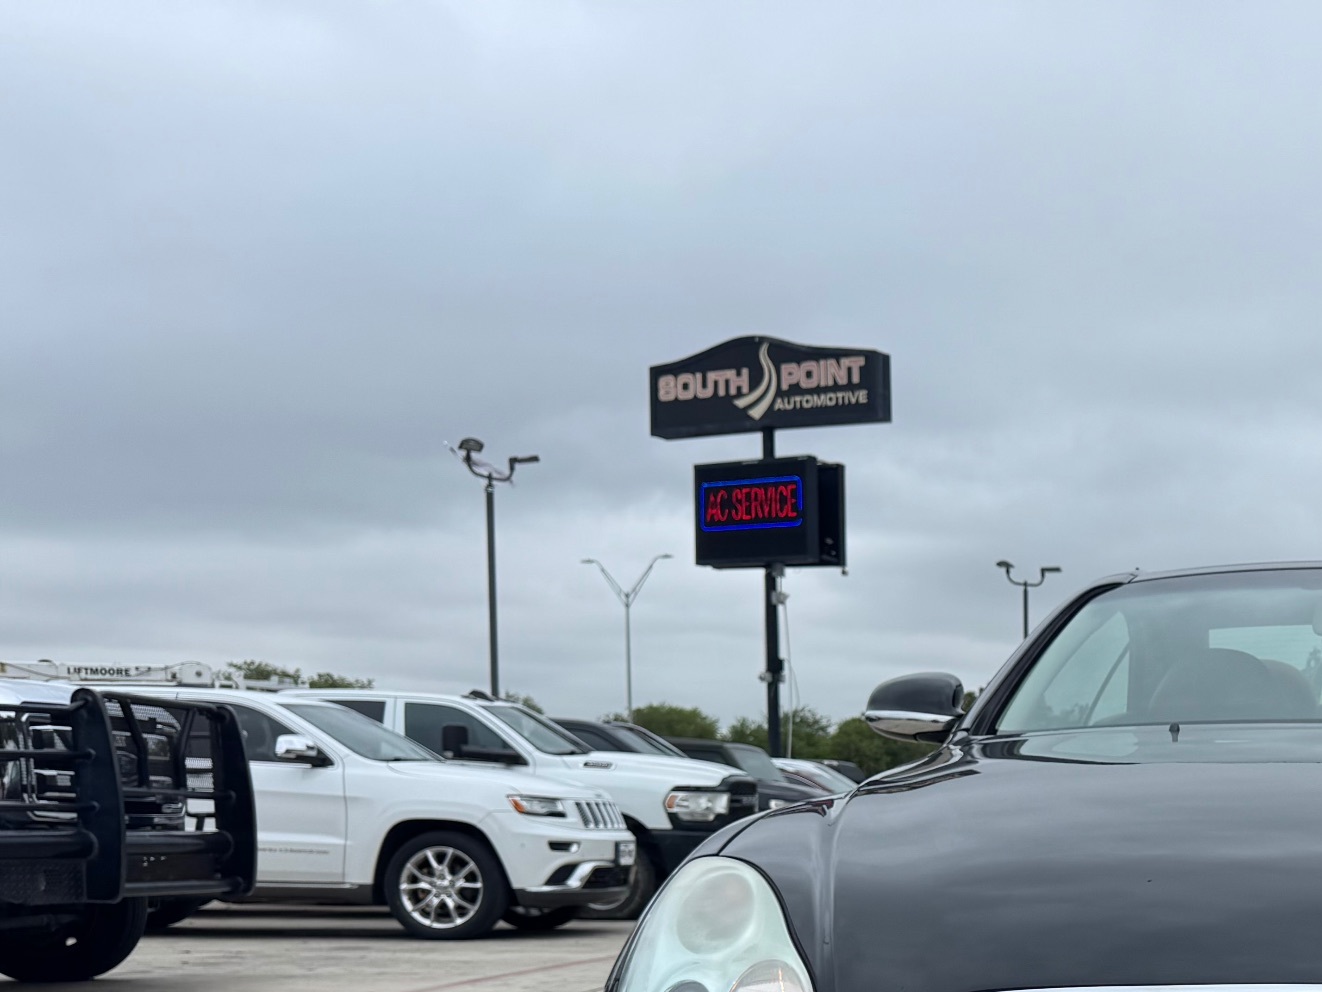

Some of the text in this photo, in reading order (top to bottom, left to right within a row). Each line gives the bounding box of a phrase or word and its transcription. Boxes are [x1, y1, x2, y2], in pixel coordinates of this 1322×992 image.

[657, 356, 866, 402] SOUTH POINT
[774, 390, 869, 411] AUTOMOTIVE
[706, 484, 798, 522] AC SERVICE
[66, 665, 131, 677] LIFTMOORE
